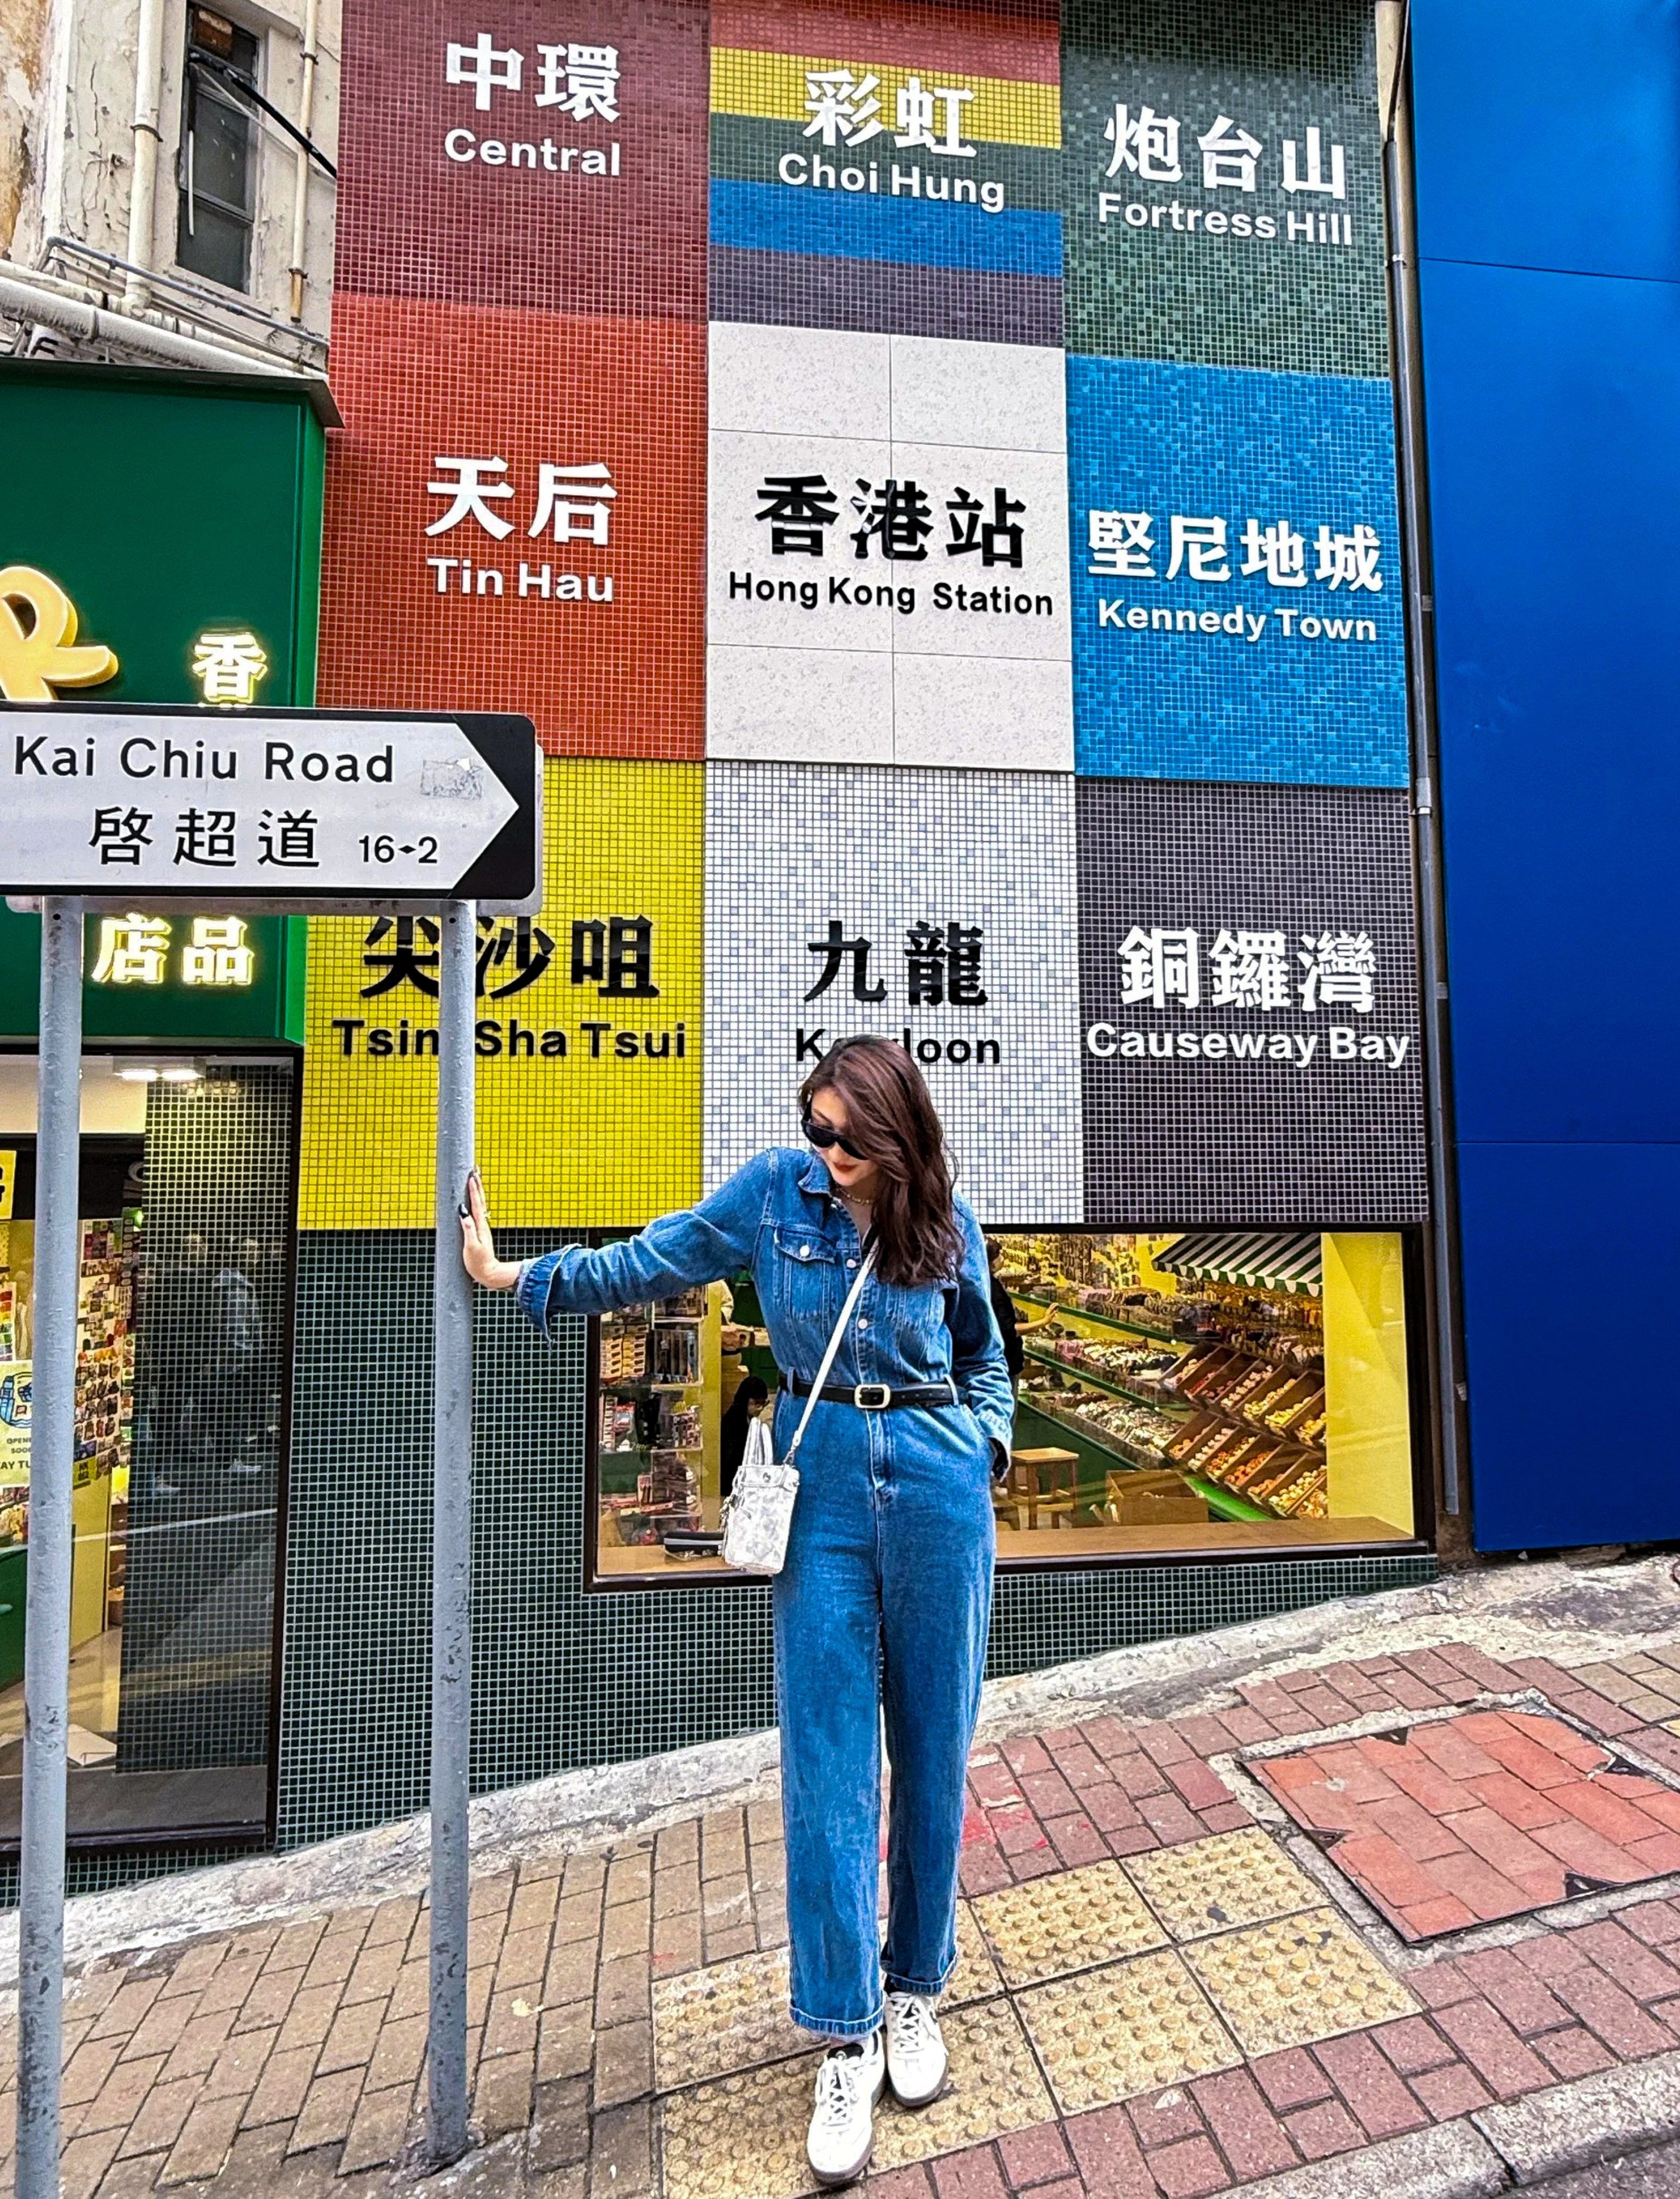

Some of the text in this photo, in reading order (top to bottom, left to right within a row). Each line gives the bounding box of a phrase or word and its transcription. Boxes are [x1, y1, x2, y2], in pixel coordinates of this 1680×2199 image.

[445, 33, 620, 122] 中環
[803, 69, 976, 157] 彩虹
[445, 128, 620, 176] Central
[1103, 104, 1346, 200] 炮台山
[779, 154, 1004, 213] Choi Hung
[1099, 193, 1352, 245] Fortress Hill
[424, 456, 618, 545] 天后
[755, 475, 1027, 568] 香港站
[1088, 509, 1384, 592] 堅尼地城
[427, 558, 614, 602] Tin Hau
[729, 572, 1052, 615] Hong Kong Station
[1099, 599, 1377, 642] Kennedy Town
[14, 736, 392, 783] Kai Chiu Road
[89, 806, 319, 868] 啓超道
[803, 920, 988, 1006] 九龍
[1117, 925, 1378, 1014] 銅鑼灣
[332, 1020, 685, 1058] Tsin Sha Tsui
[797, 1028, 1000, 1064] Kloon
[1086, 1023, 1410, 1068] Causeway Bay
[0, 1461, 14, 1469] AY
